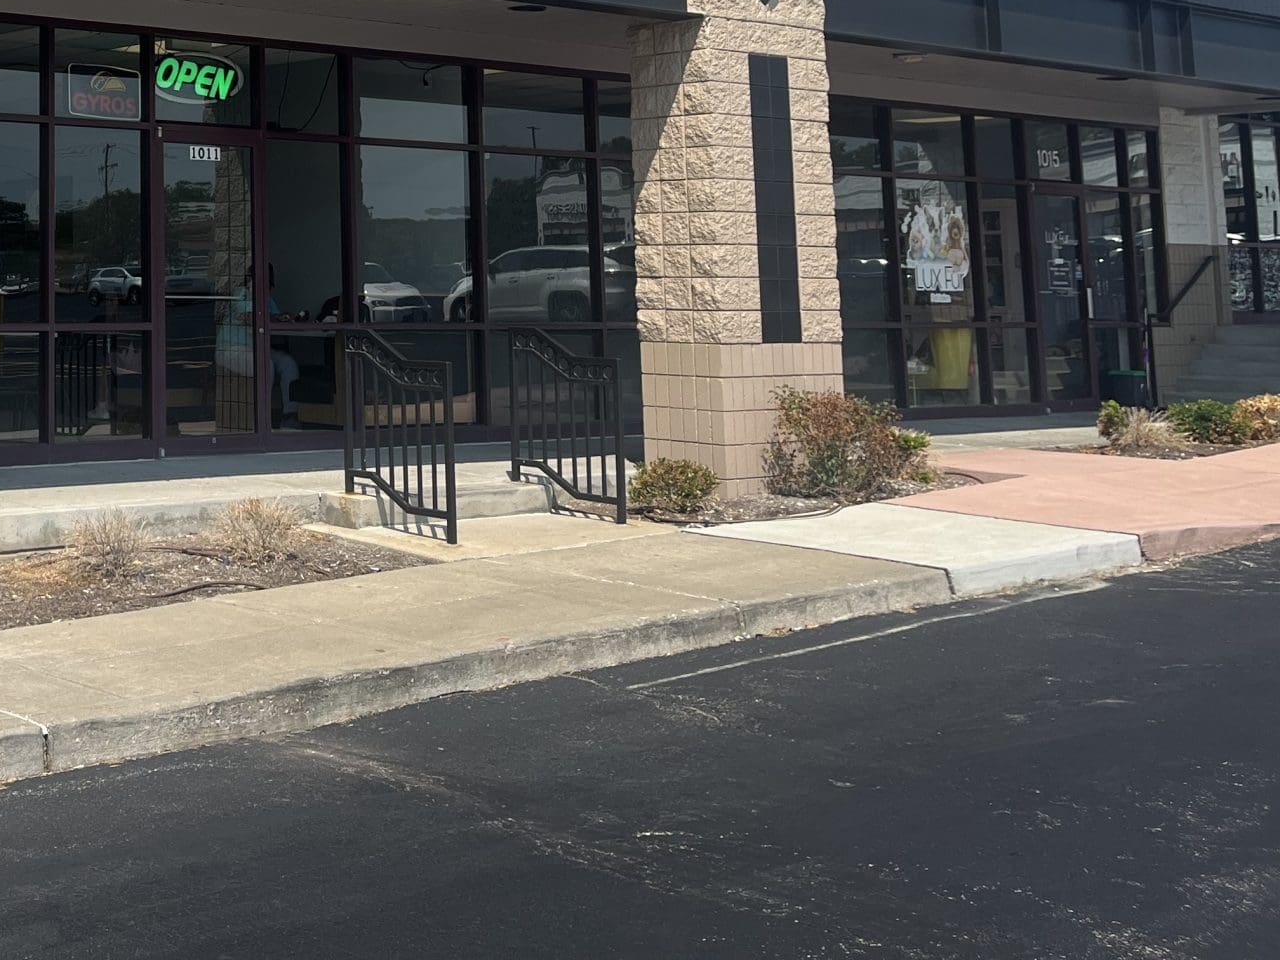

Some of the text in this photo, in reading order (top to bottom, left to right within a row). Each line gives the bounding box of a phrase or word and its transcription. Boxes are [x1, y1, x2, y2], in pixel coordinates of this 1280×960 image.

[156, 57, 235, 100] OPEN
[72, 93, 137, 115] GYROS
[192, 147, 219, 160] 1011
[1036, 149, 1060, 168] 1015
